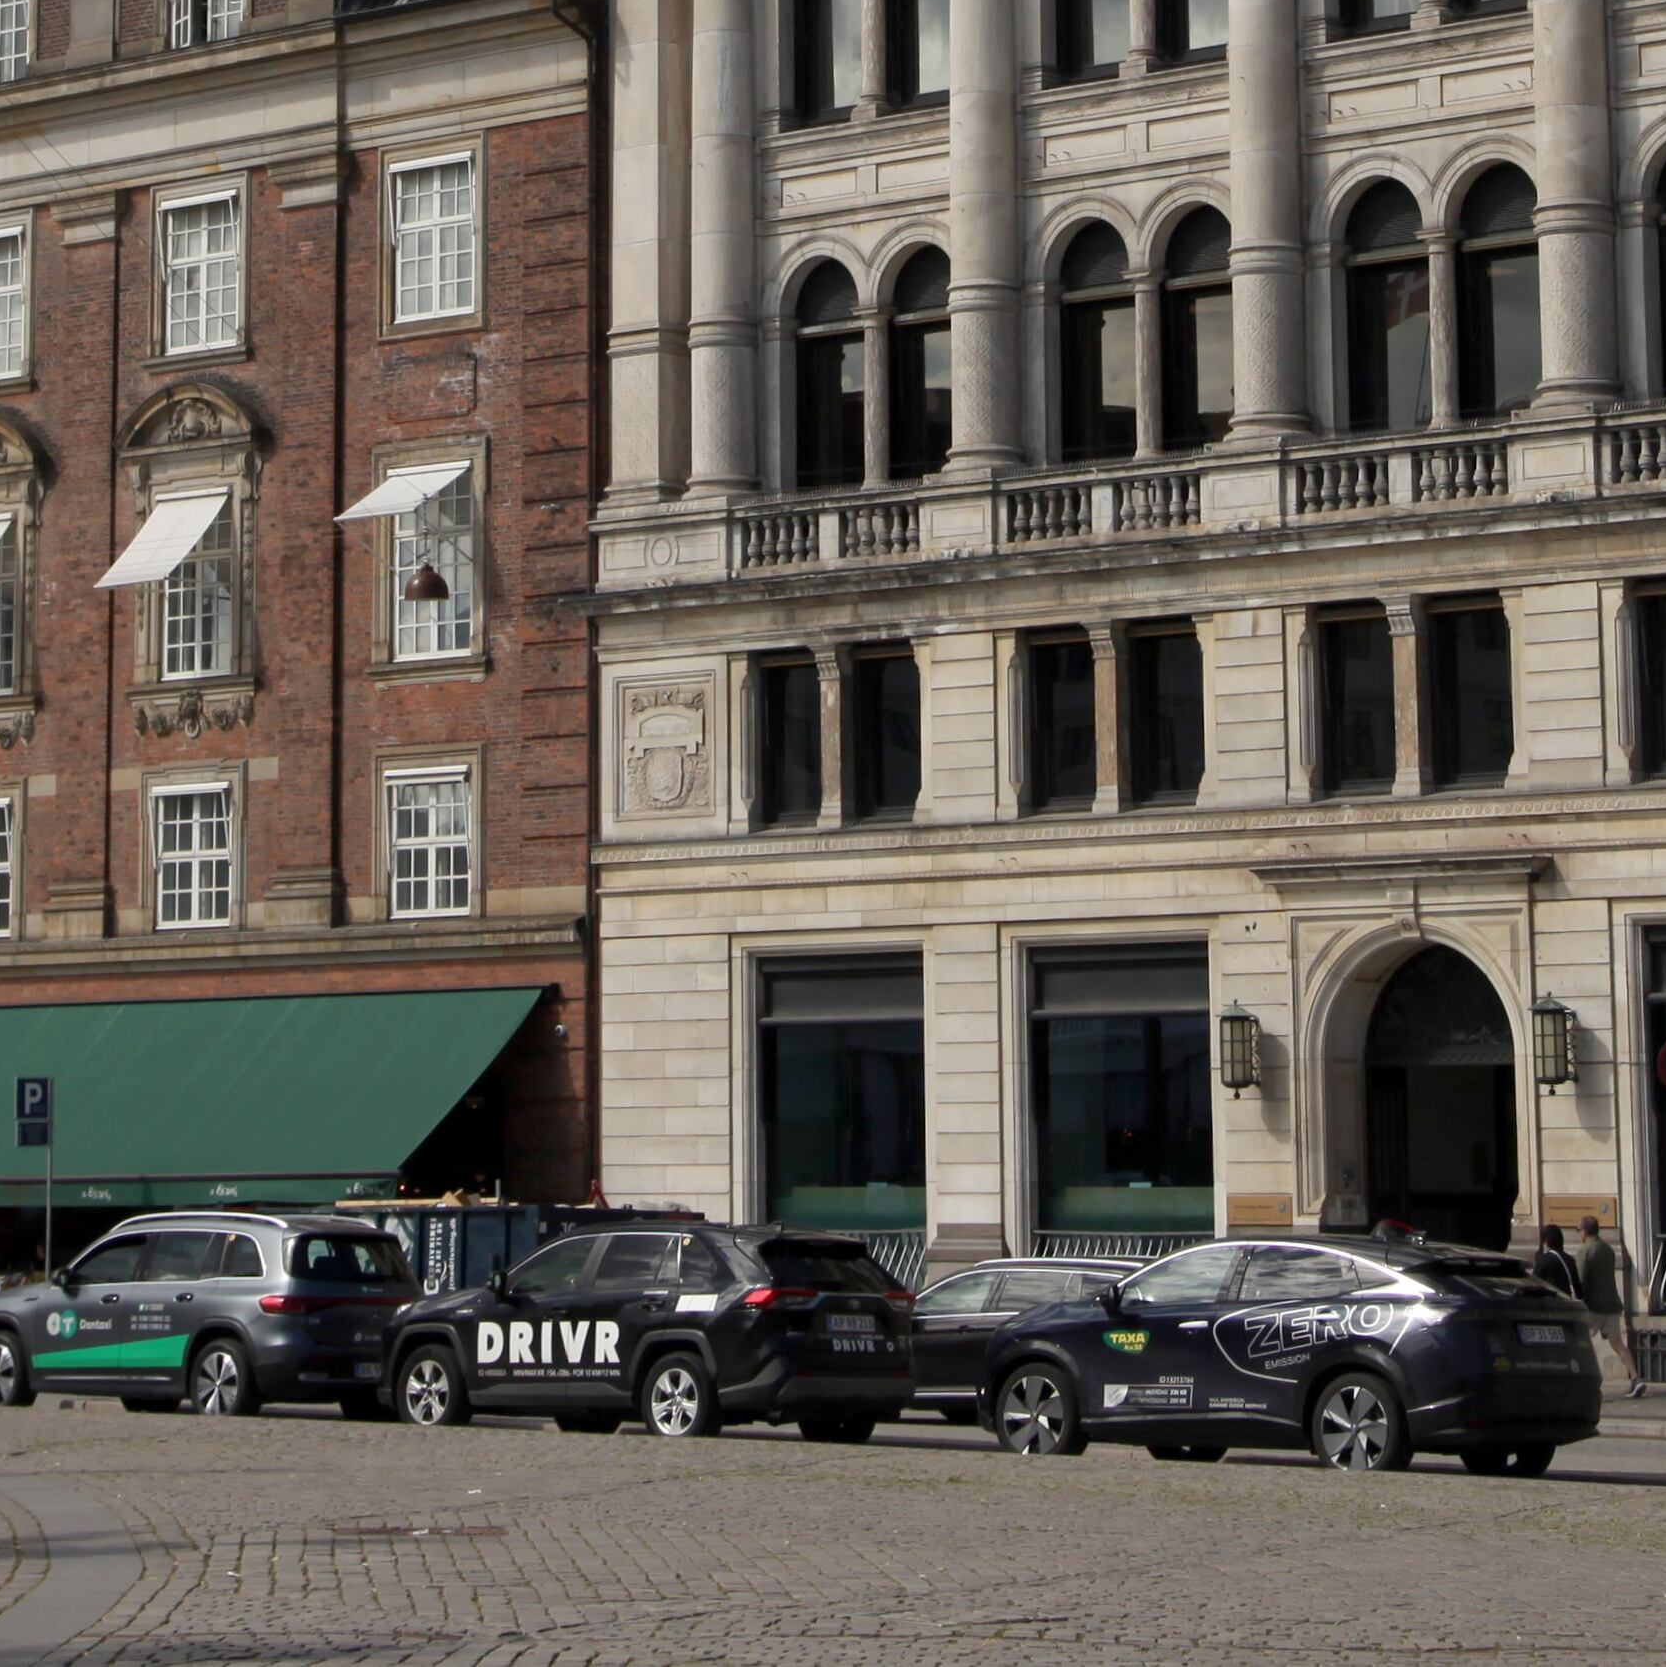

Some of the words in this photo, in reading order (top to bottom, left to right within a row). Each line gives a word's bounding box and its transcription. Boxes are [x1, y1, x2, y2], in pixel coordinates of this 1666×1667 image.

[25, 1082, 42, 1114] P
[79, 1318, 113, 1331] Dantaxi
[1244, 1301, 1394, 1358] ZERO
[477, 1321, 621, 1364] DRIVR
[833, 1339, 875, 1353] DRIVR
[1110, 1332, 1146, 1344] TAXA
[1265, 1353, 1311, 1370] EMISSION
